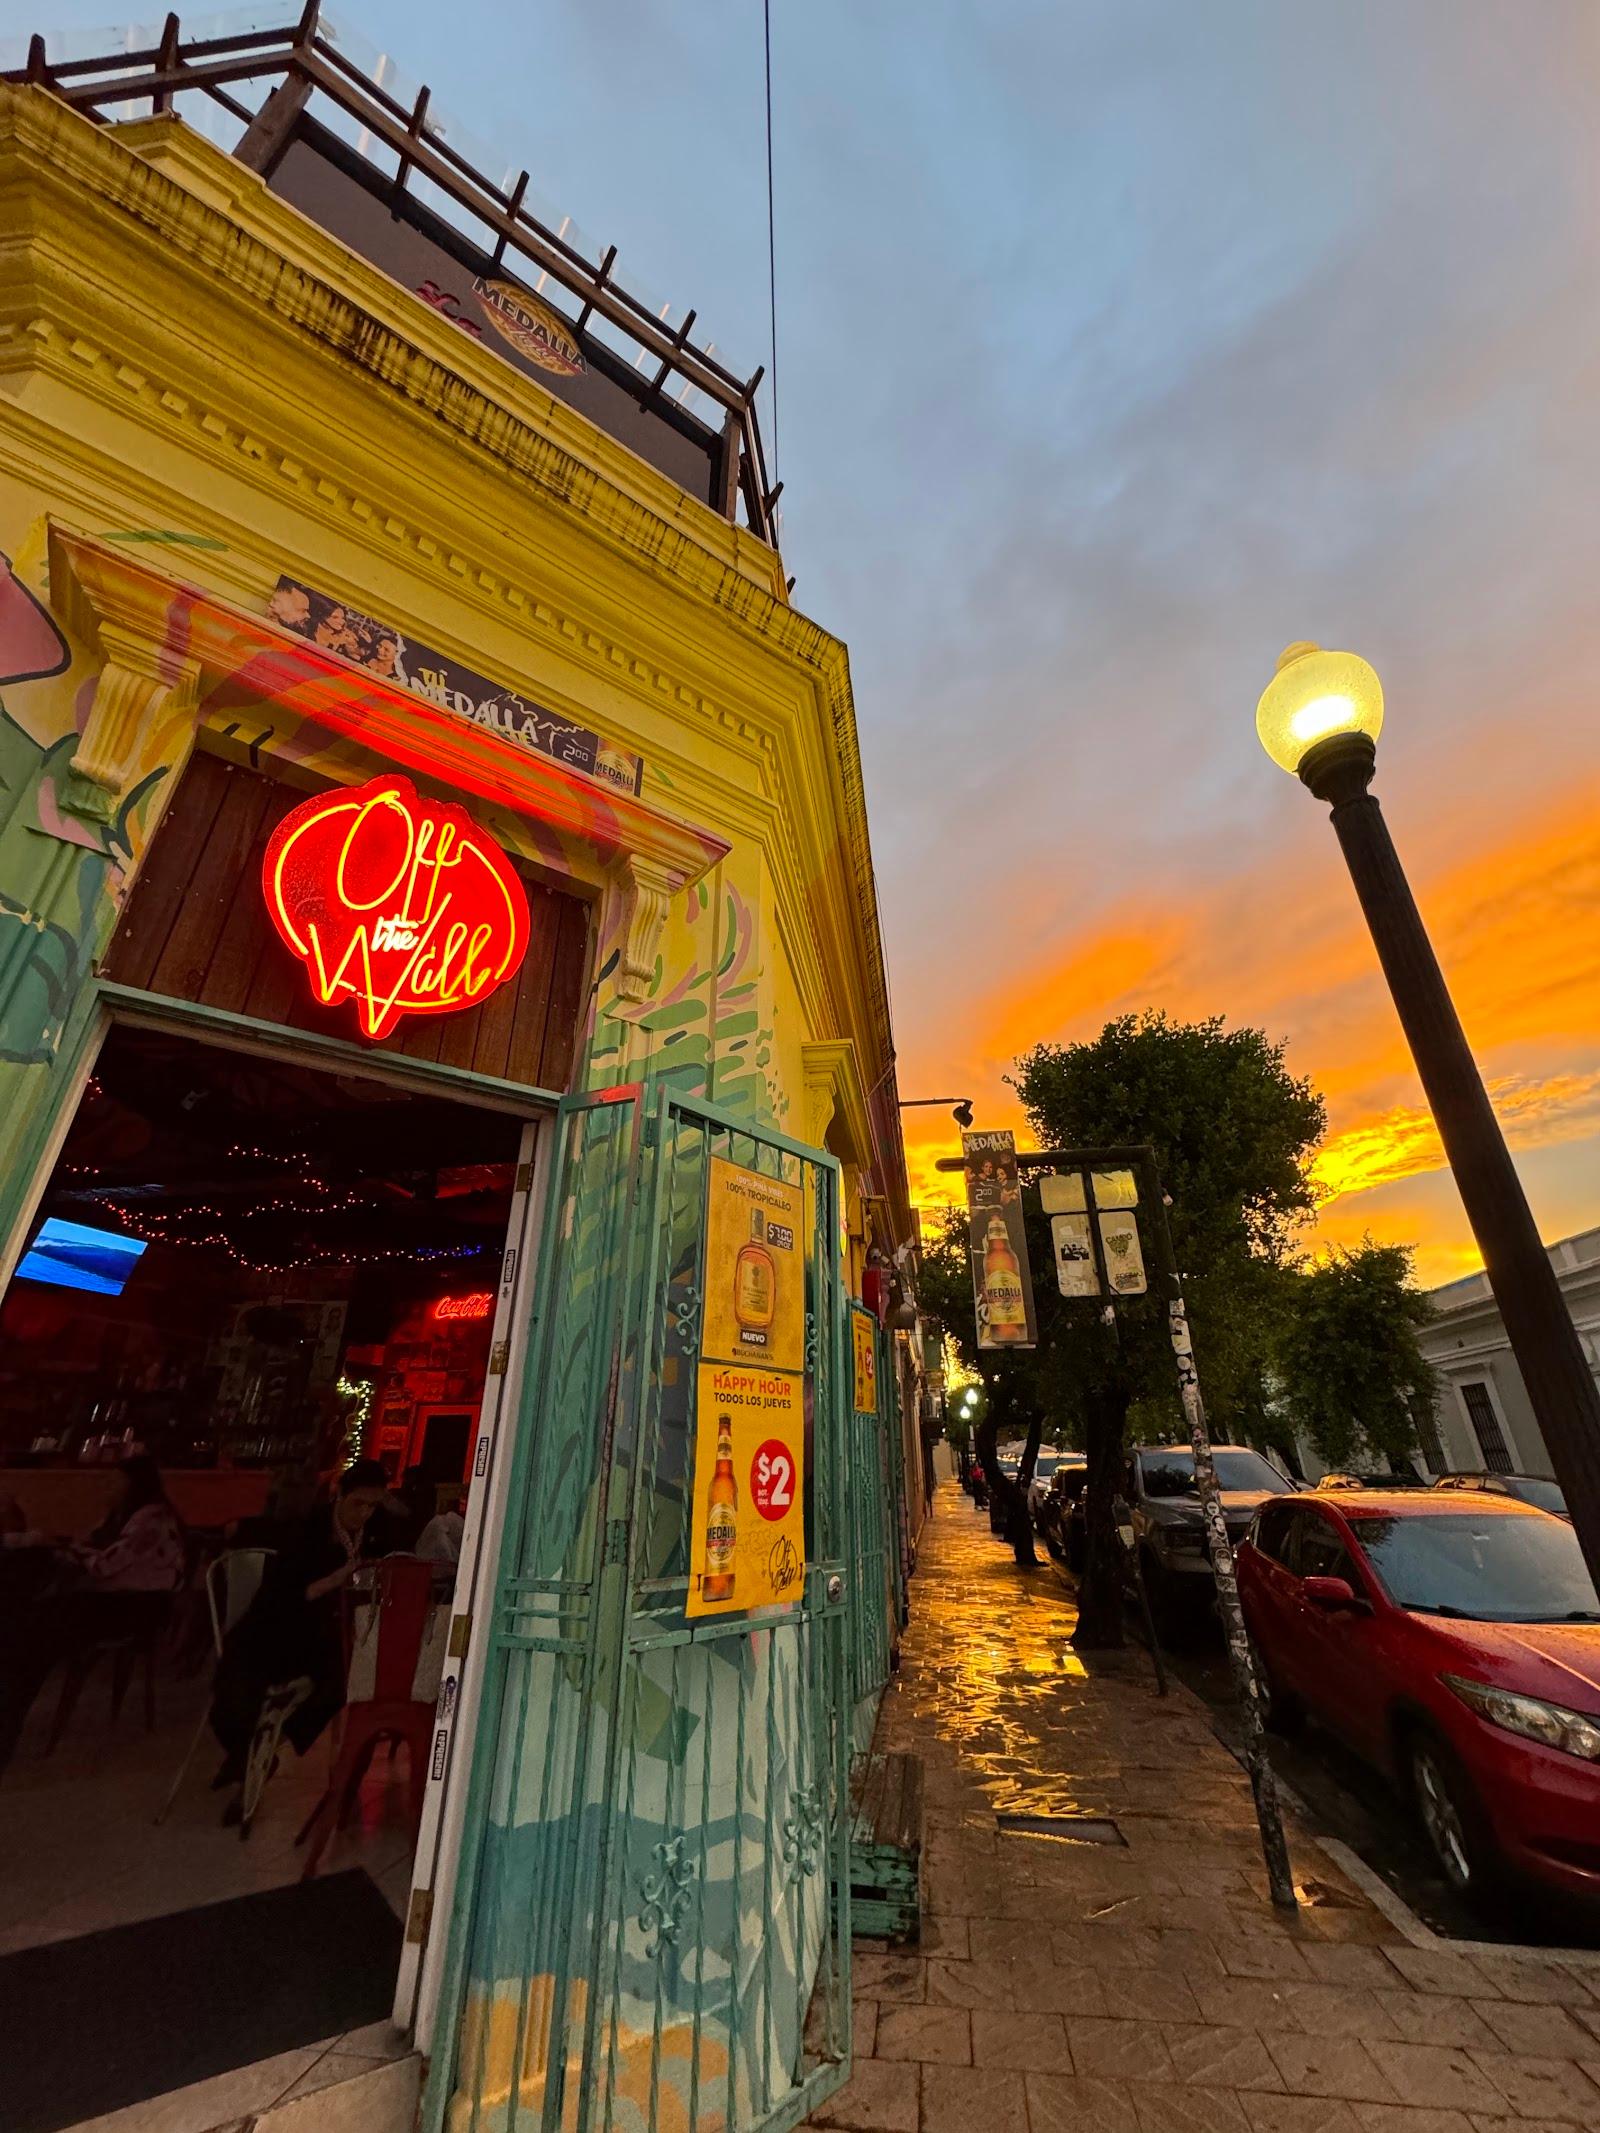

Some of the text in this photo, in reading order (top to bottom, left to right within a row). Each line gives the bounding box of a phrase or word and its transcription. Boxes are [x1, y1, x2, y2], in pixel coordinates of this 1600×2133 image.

[472, 277, 588, 375] MEDALLA
[411, 676, 539, 743] MEDALLA
[337, 790, 462, 924] Off
[371, 914, 419, 952] the
[308, 892, 492, 1034] Wall
[963, 1132, 1013, 1152] MEDALLA
[726, 1181, 791, 1211] 100% TROPICALEO
[742, 1331, 765, 1343] NUEVO
[714, 1374, 791, 1396] HAPPY HOUR
[714, 1392, 791, 1409] TODOS LOS JUEVES
[757, 1452, 790, 1505] $2
[706, 1526, 736, 1539] MEDALL
